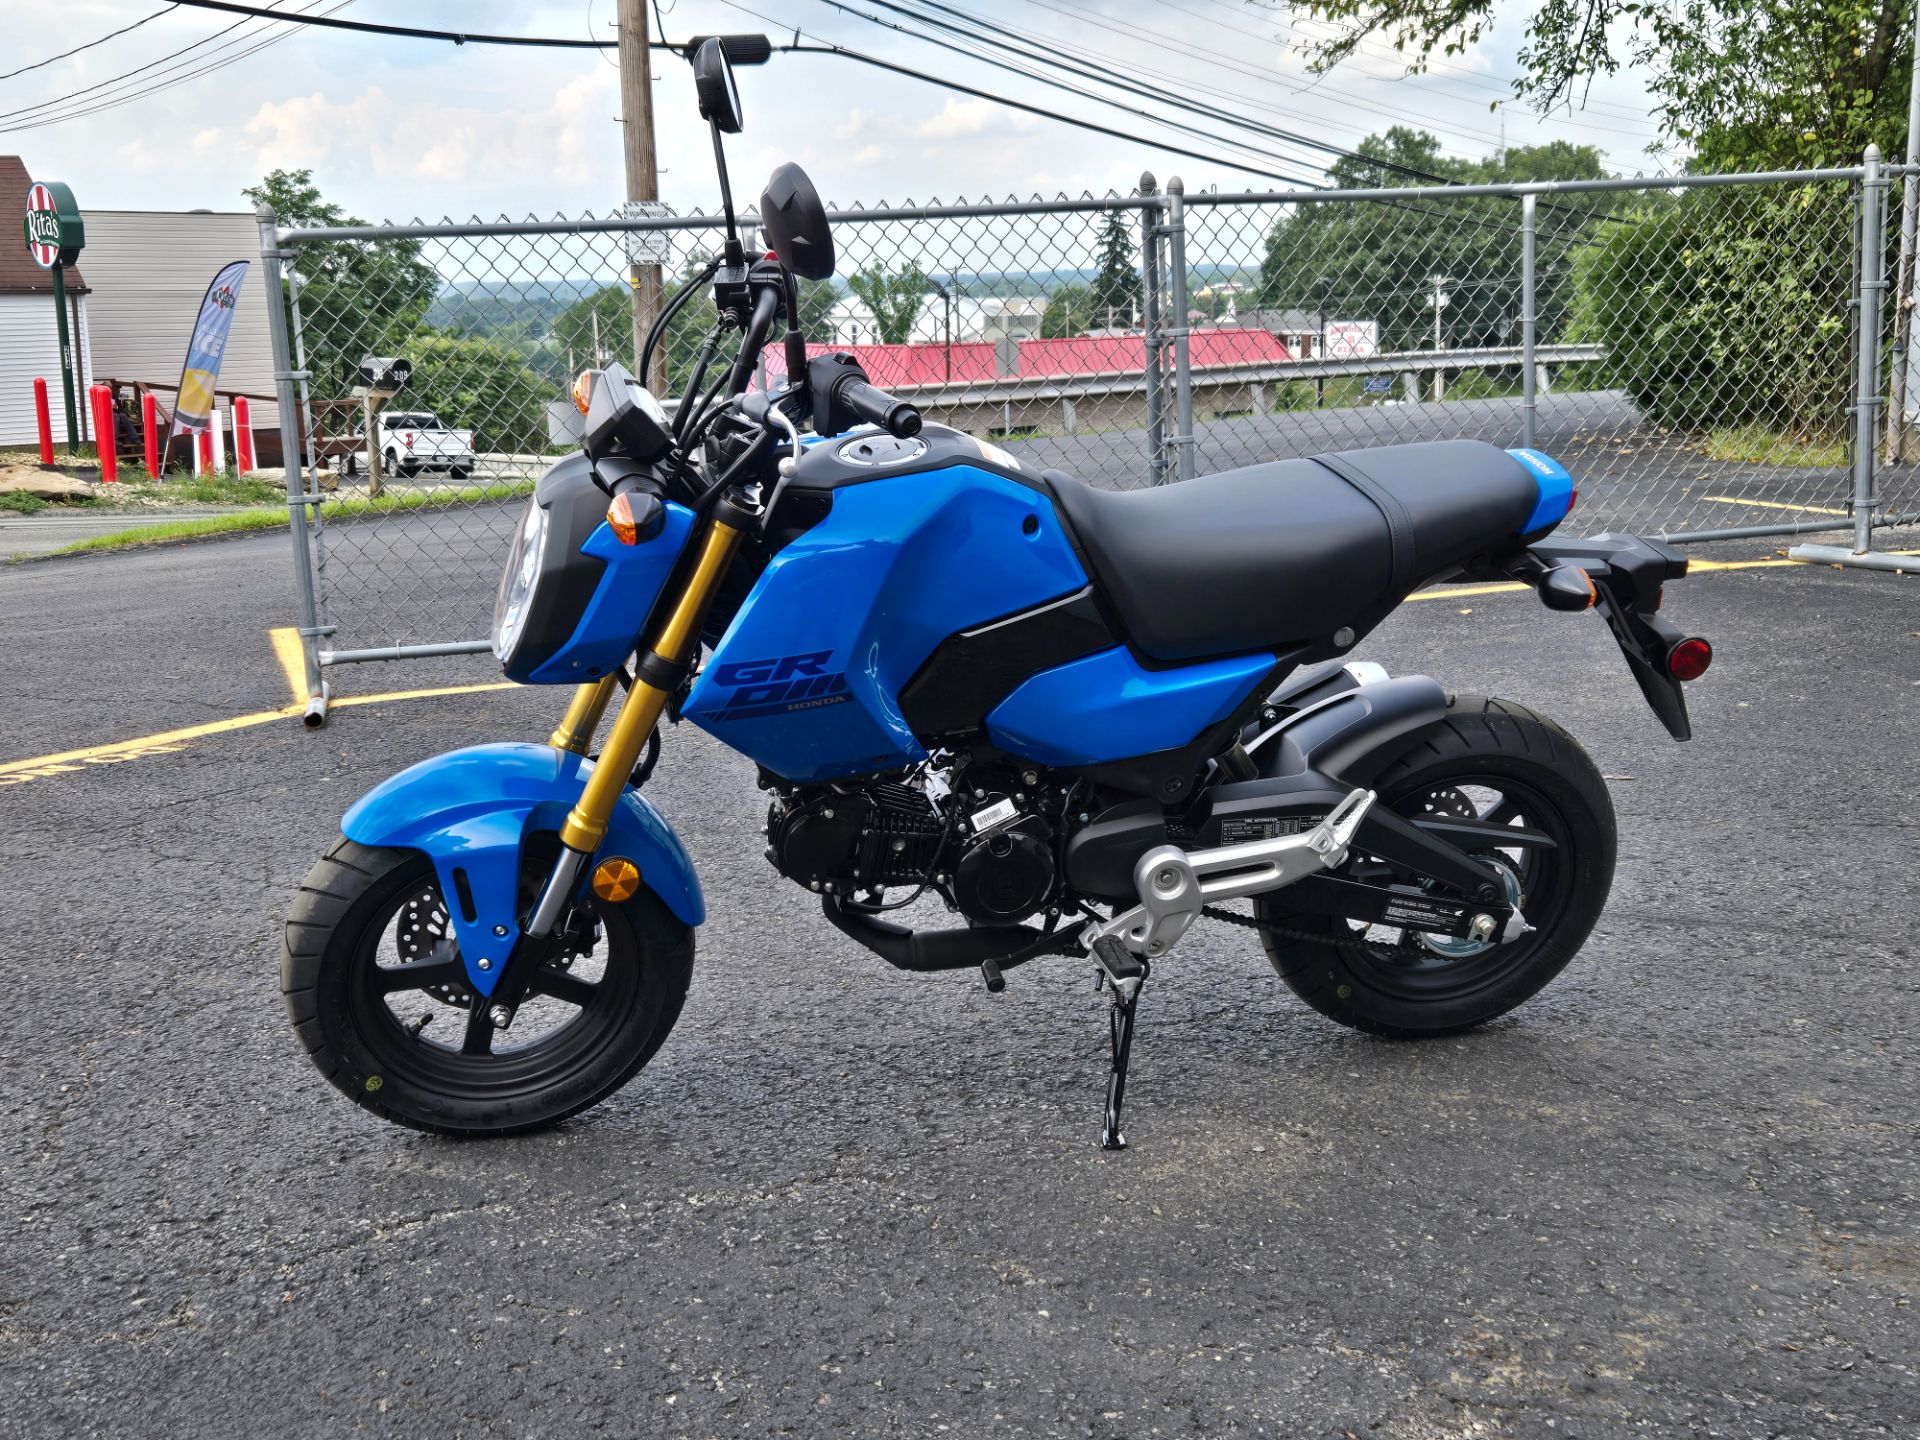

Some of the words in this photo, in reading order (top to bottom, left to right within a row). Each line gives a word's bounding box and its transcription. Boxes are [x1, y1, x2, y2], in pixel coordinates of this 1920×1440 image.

[27, 210, 59, 242] Rita's
[394, 370, 408, 380] 209
[1519, 450, 1554, 475] HONDA
[787, 696, 846, 711] HONDA
